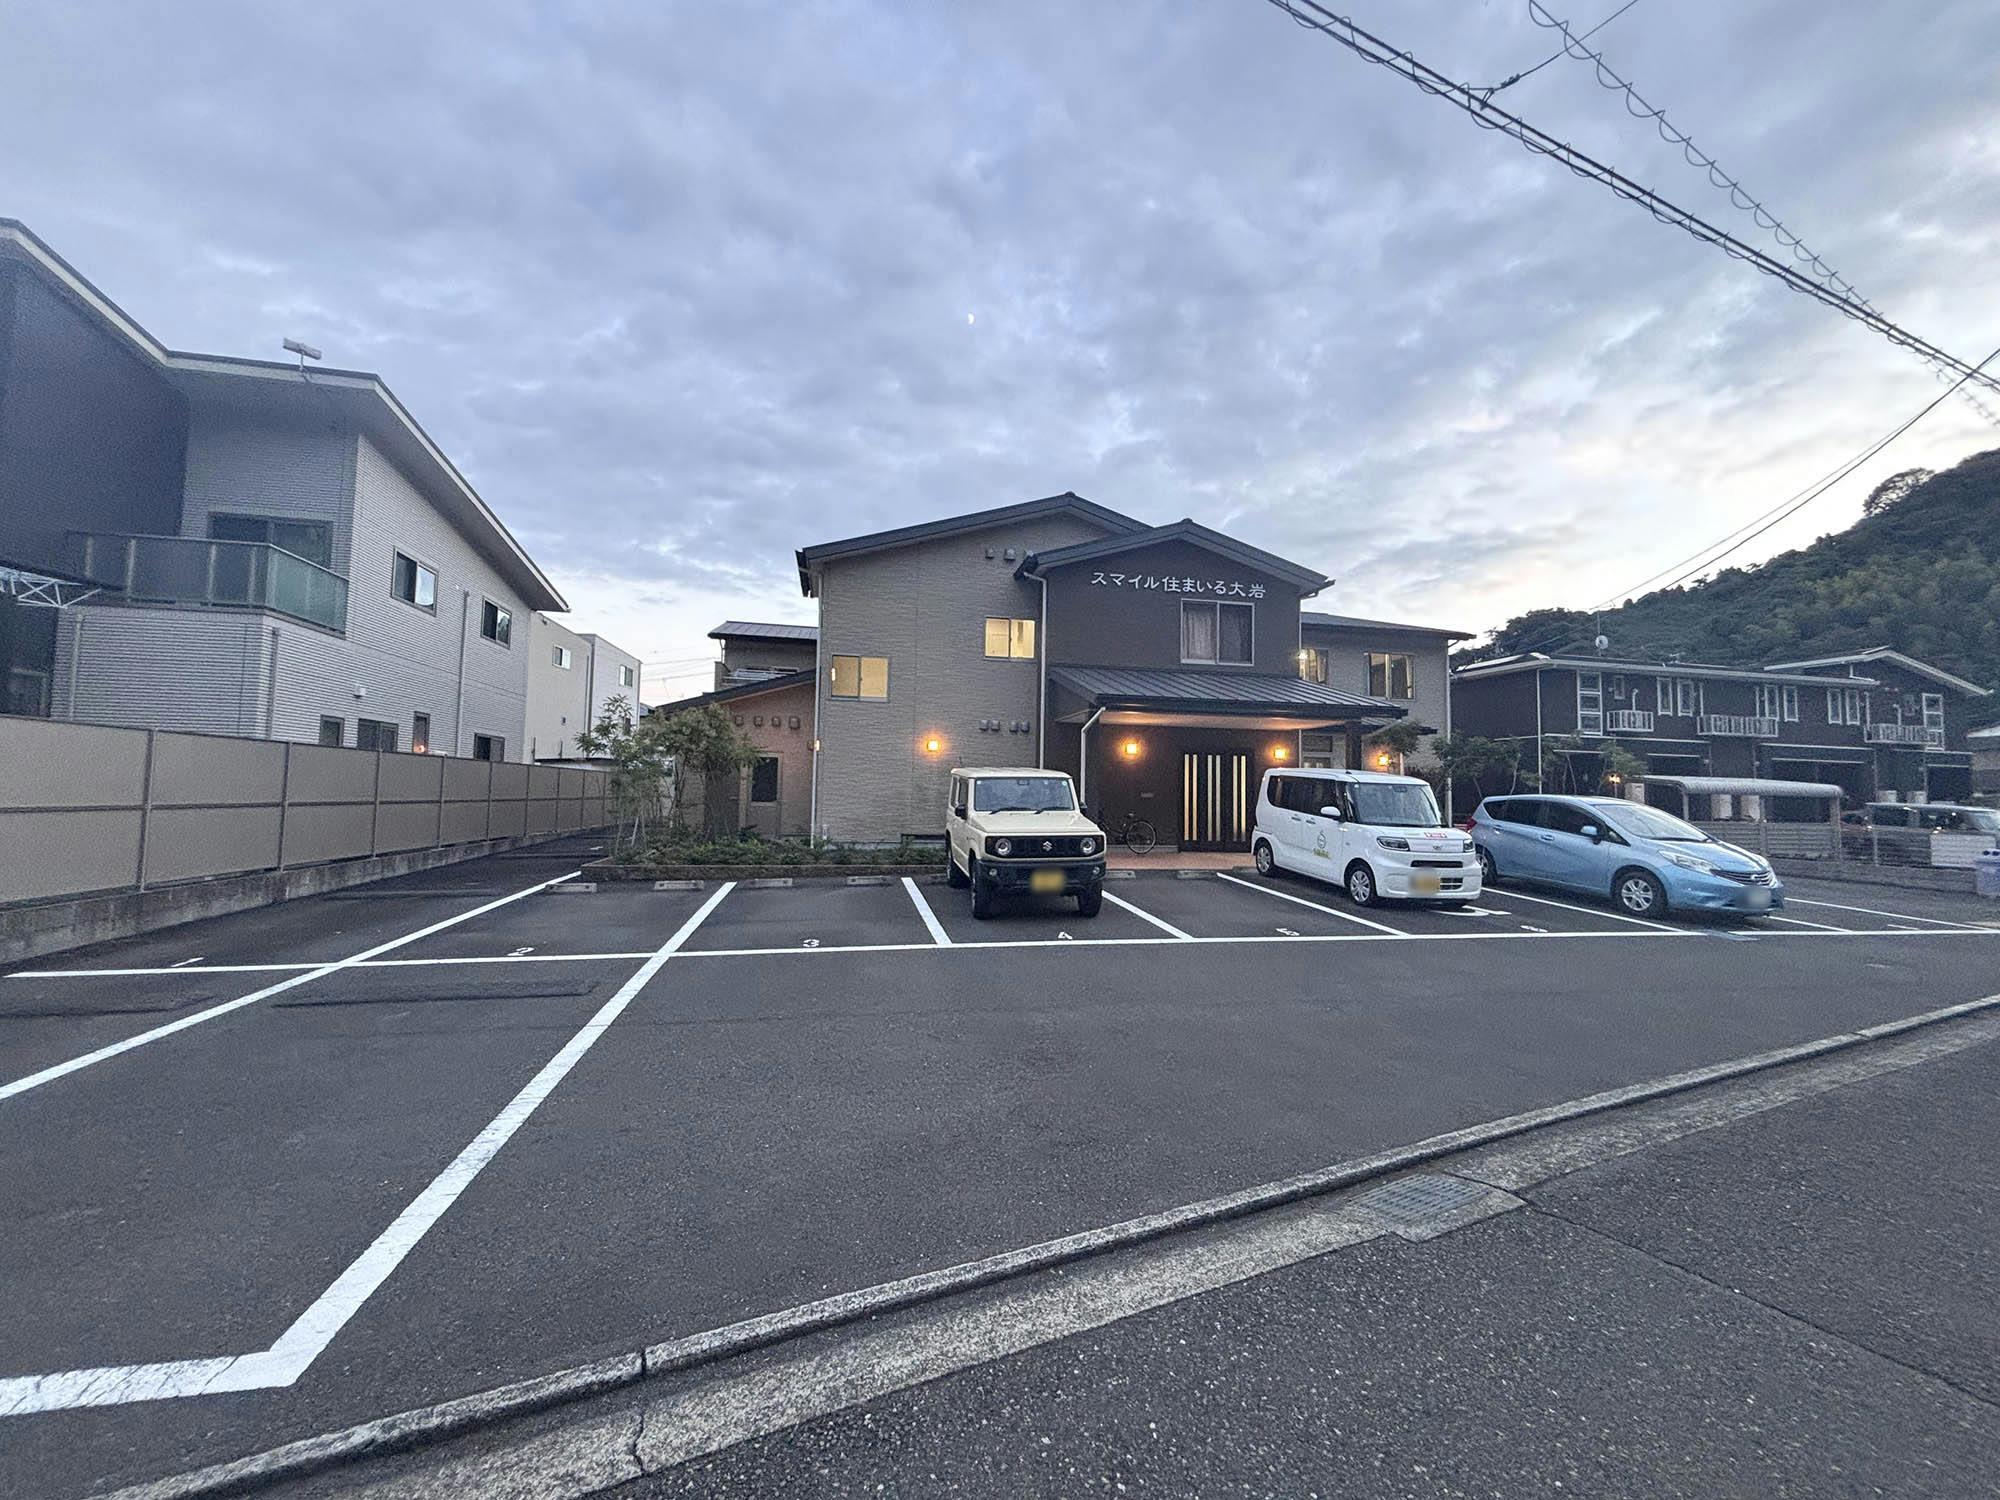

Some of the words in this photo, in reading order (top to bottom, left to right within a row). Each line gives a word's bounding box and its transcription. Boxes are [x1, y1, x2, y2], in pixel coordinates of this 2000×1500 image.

[1091, 572, 1266, 599] スマイル住まいる大岩
[802, 939, 820, 948] 3
[507, 947, 535, 956] 2
